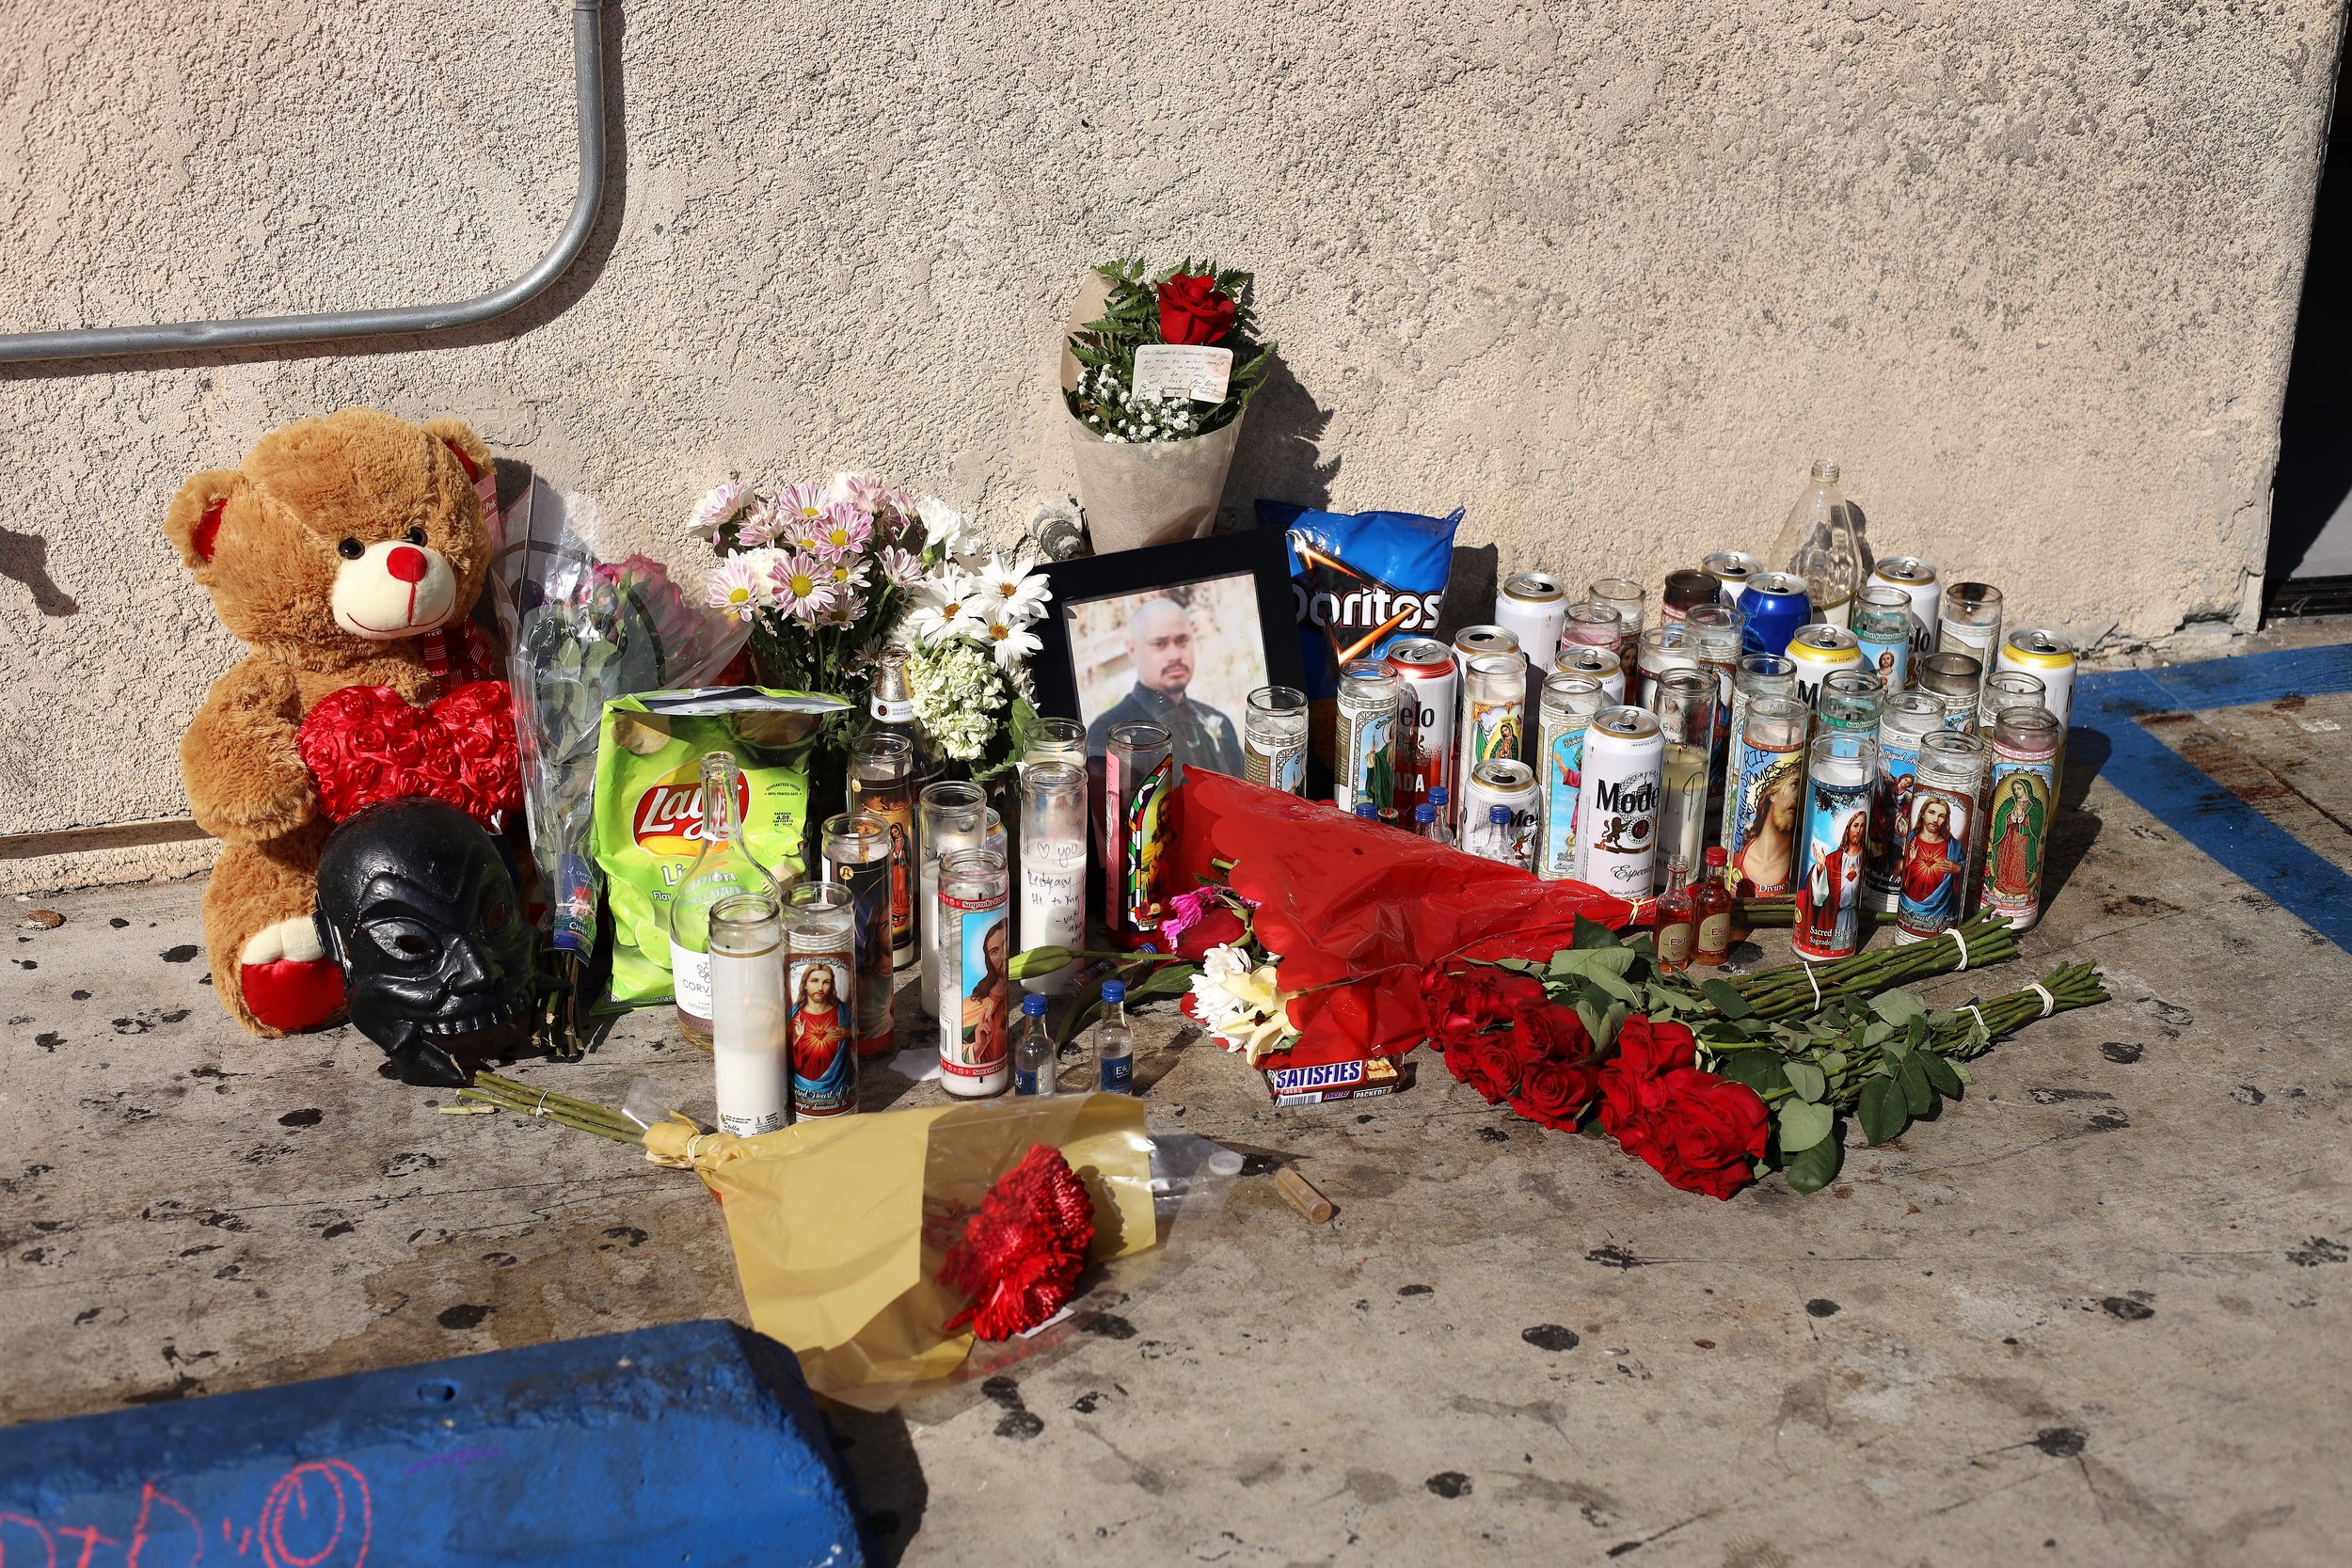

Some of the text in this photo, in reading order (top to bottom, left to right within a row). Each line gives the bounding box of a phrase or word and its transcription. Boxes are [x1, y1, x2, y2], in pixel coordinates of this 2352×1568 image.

[1399, 701, 1435, 728] elo
[1744, 749, 1770, 769] RIP
[1757, 883, 1786, 893] Divine
[962, 900, 993, 910] Sagrado
[1809, 925, 1833, 937] Sacred
[1276, 1060, 1360, 1089] SATISFIES
